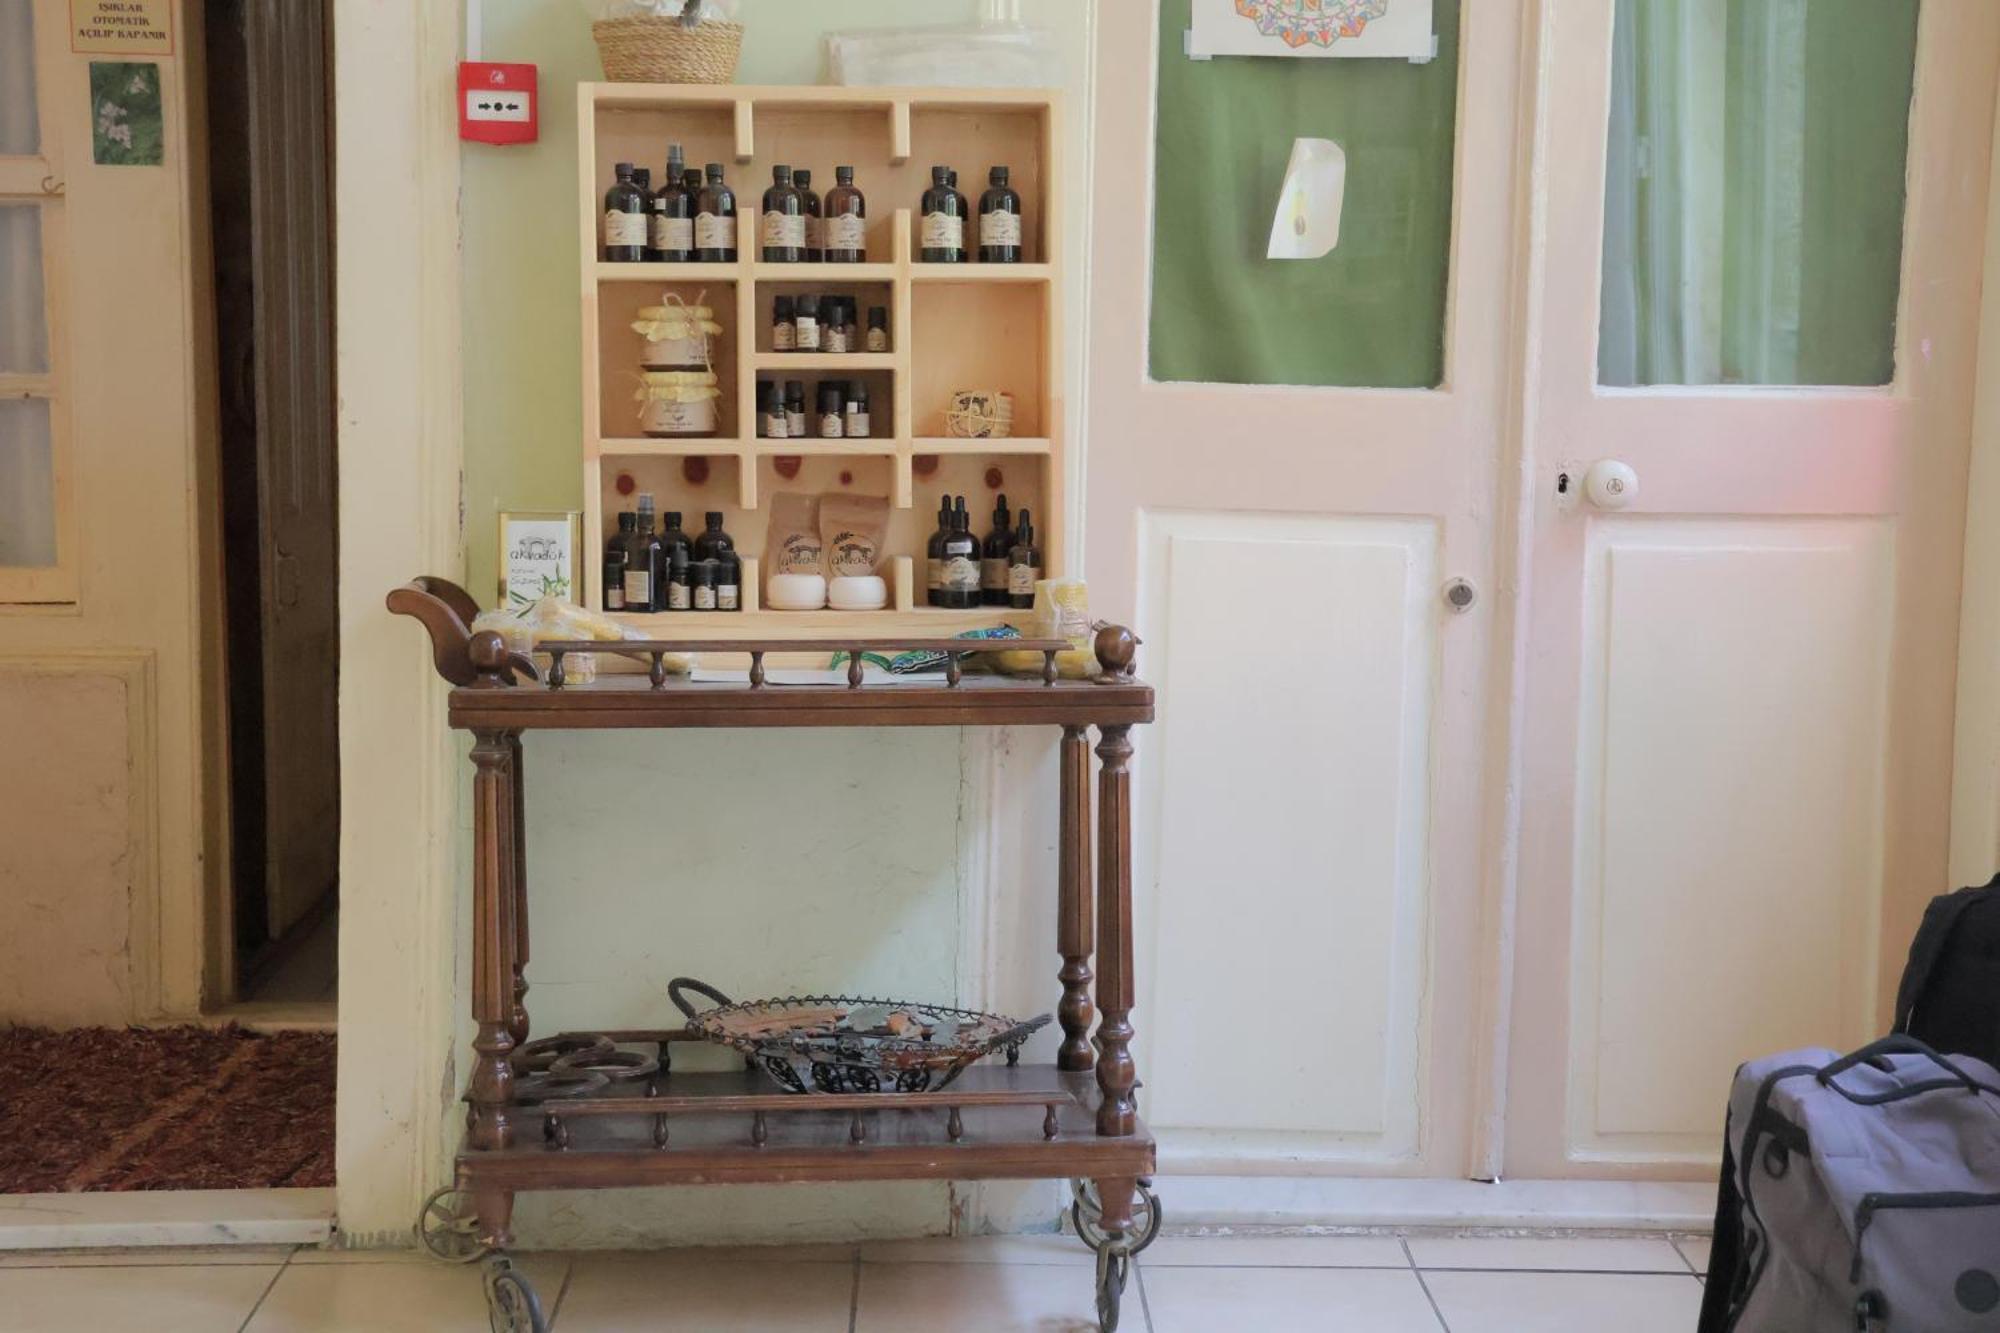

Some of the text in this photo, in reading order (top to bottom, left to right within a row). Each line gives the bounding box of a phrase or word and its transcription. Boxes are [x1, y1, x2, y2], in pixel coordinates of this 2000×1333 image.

[98, 1, 143, 13] IŞIKLAR
[78, 28, 167, 40] AÇILIP KAPANIR
